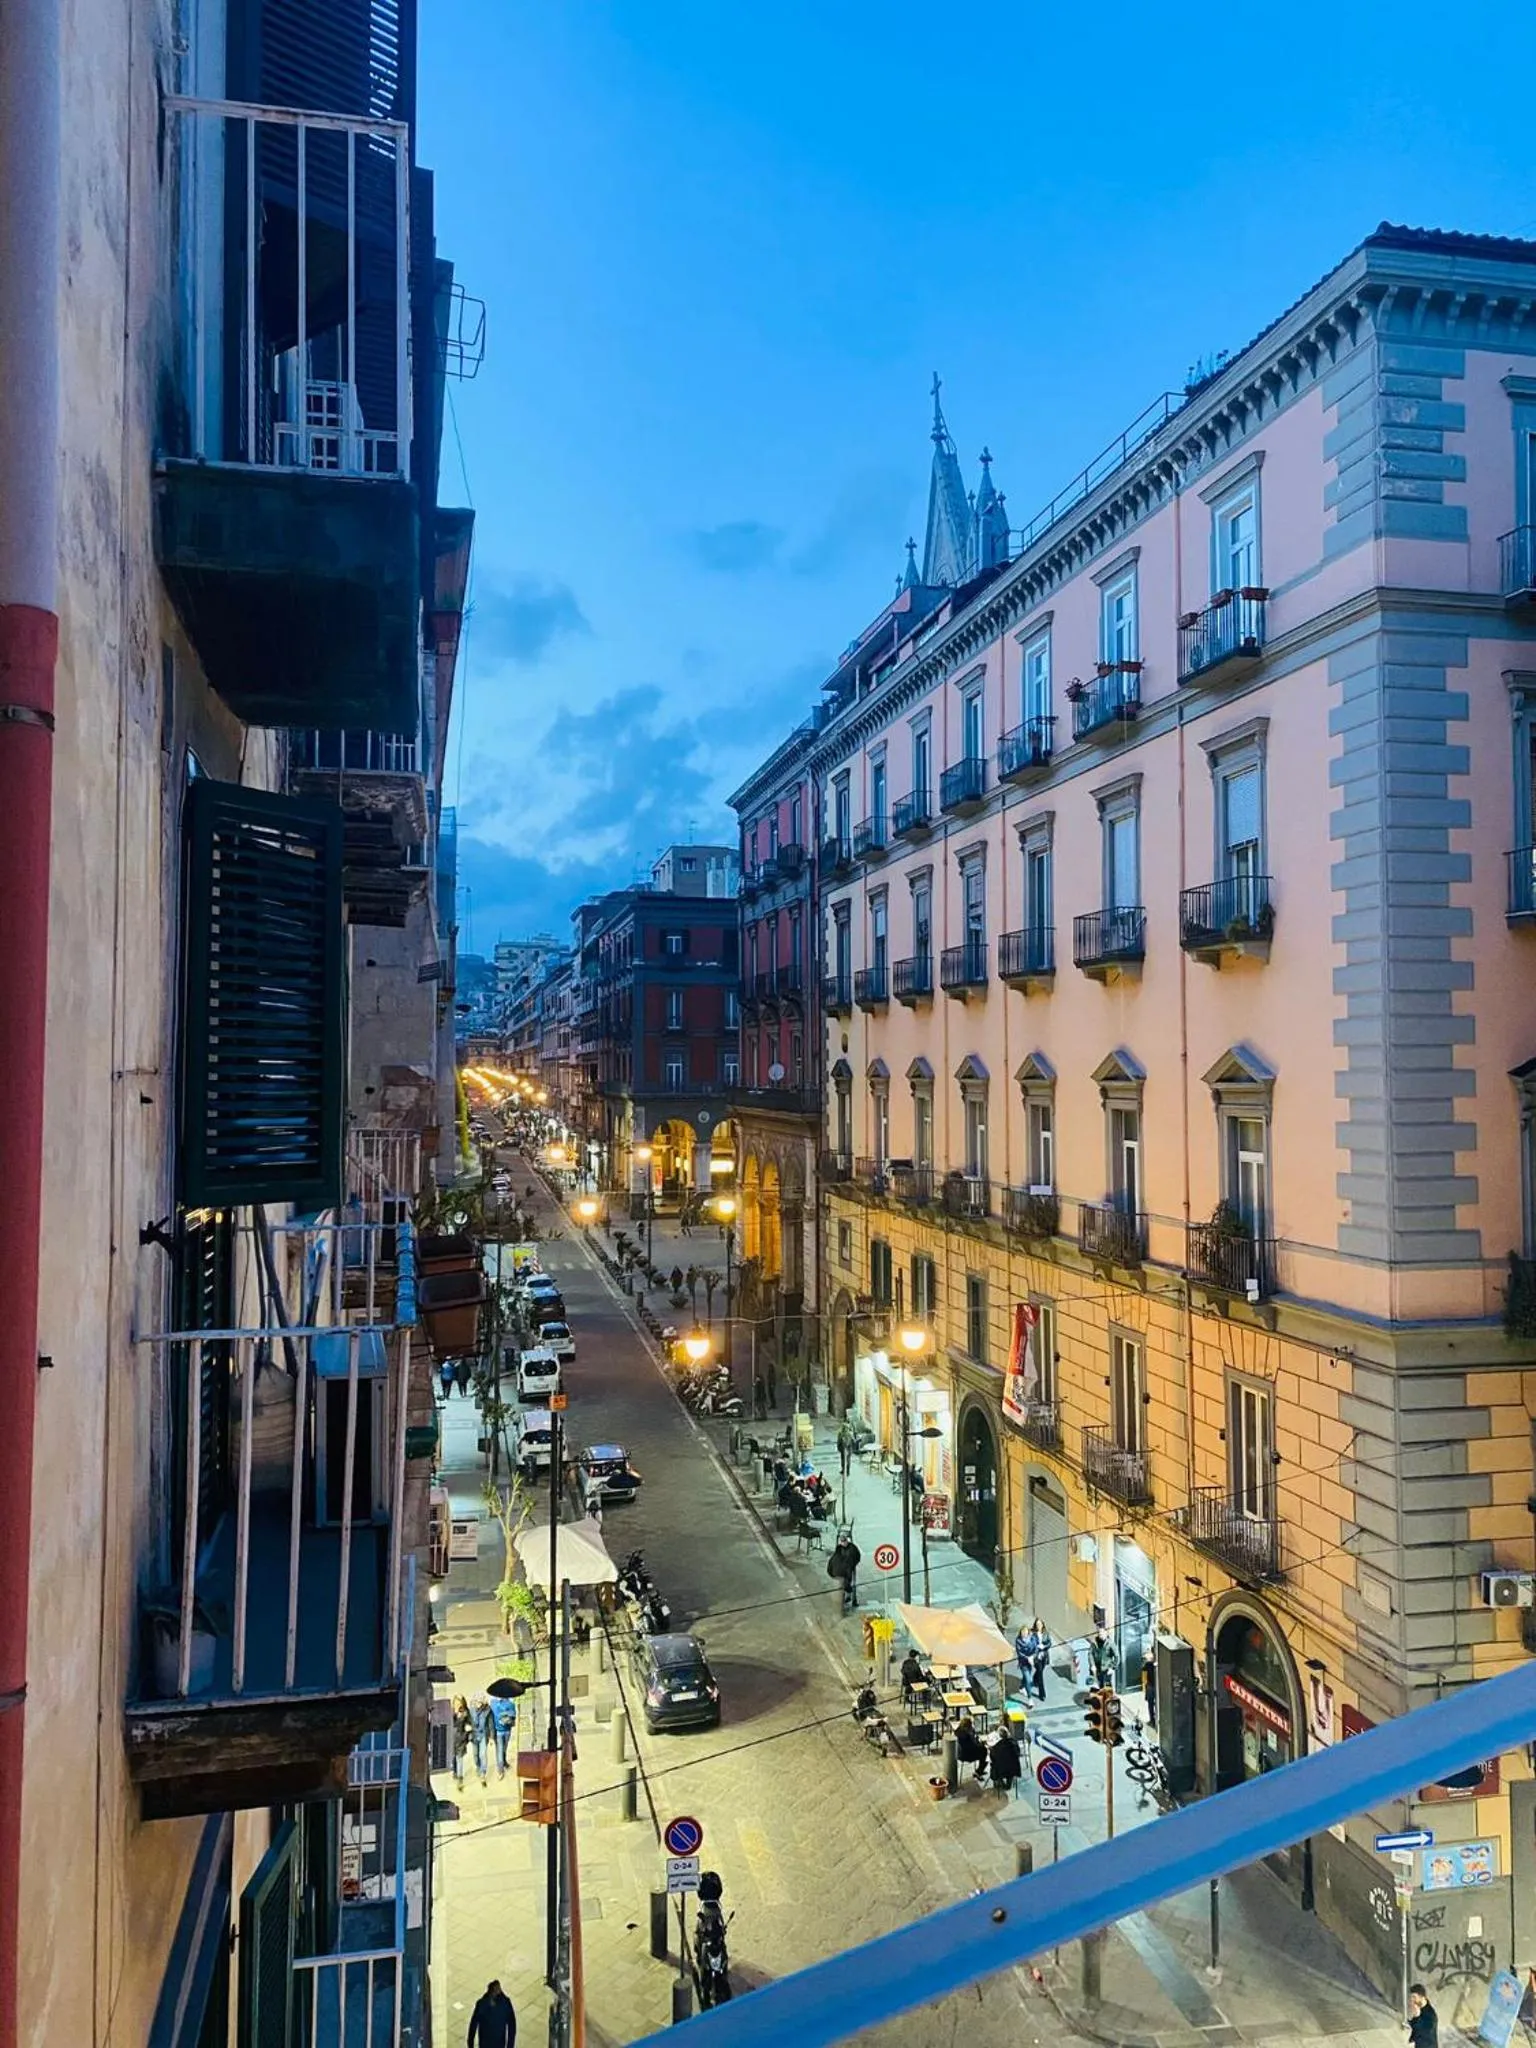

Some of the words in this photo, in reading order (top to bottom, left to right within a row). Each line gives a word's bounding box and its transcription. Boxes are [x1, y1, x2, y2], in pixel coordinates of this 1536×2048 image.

[880, 1551, 894, 1564] 30
[1229, 1679, 1290, 1735] CAFFETTERI
[1043, 1798, 1067, 1807] 0-24
[673, 1862, 693, 1870] 0-24
